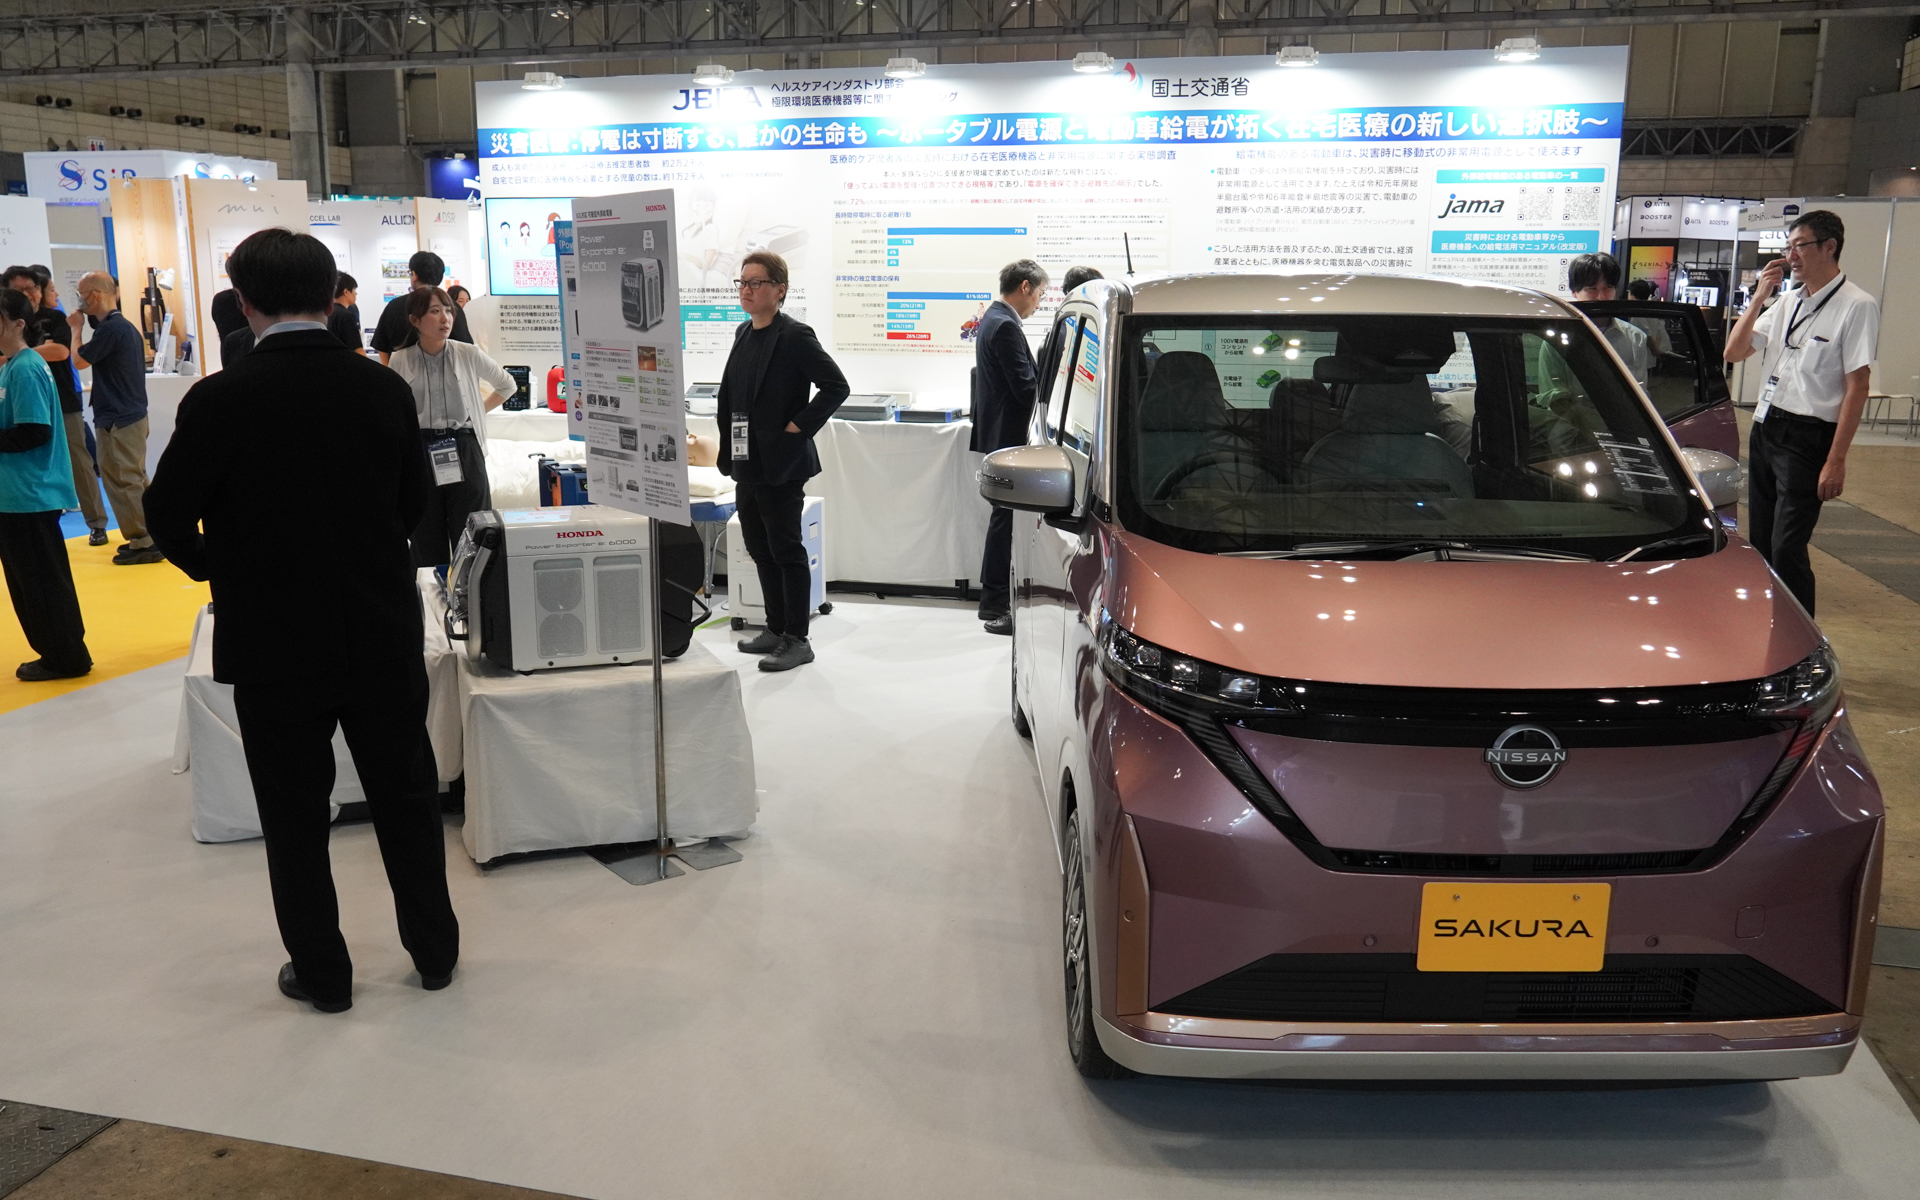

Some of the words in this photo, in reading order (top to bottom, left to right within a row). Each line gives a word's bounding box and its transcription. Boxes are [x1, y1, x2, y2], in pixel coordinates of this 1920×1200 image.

[770, 78, 905, 93] ヘルスケアインダストリ部会
[1151, 77, 1250, 98] 国土交通省
[1235, 145, 1583, 160] 給電機能のある電動車は、災害時に移動式の非常用電源として使えます
[661, 158, 705, 169] 約2万2千人
[1460, 171, 1579, 181] 外部給電機能のある電動車の一覧
[1216, 178, 1419, 188] 非常用電源として活用できます。たとえば令和元年房総
[1216, 192, 1418, 202] 半島台風や令和6年能登半島地震等の災害で、電動車の
[645, 204, 667, 212] HONDA
[1215, 205, 1367, 215] 避難所等への派遣・活用の実績があります。
[1437, 193, 1505, 219] jama
[328, 214, 341, 222] LAB
[580, 235, 605, 243] Power
[1464, 232, 1565, 241] 災害時における電動車等から
[581, 248, 617, 258] Exporter
[1213, 244, 1414, 255] こうした活用方法を普及するため、国土交通省では、経済
[582, 262, 607, 272] 6000
[1213, 257, 1413, 268] 産業省とともに、医療機器を含む電気製品への災害時に
[835, 274, 900, 282] 非常時の独立電源の保有
[556, 530, 605, 539] HONDA
[556, 541, 597, 549] Exporter
[608, 538, 637, 546] 6000
[1487, 750, 1567, 763] NISSAN
[1434, 919, 1594, 938] SAKURA
